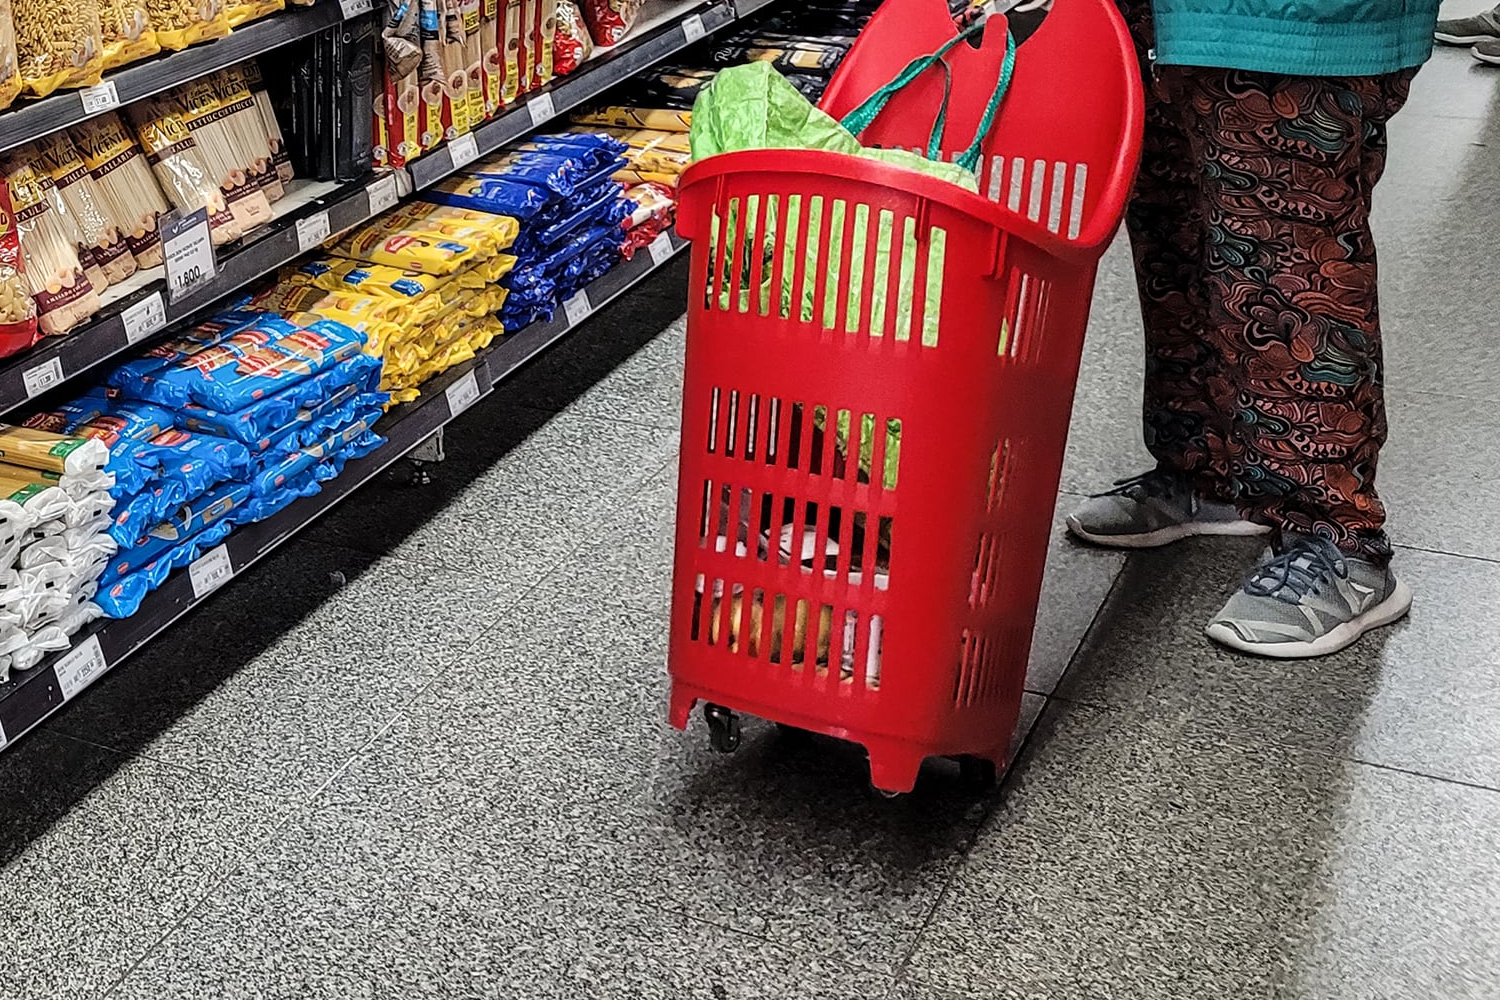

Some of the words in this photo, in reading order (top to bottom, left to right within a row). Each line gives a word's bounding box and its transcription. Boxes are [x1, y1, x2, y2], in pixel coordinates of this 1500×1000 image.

[212, 79, 249, 102] VICENT
[78, 128, 128, 160] VICENTE
[15, 201, 49, 222] TALLA
